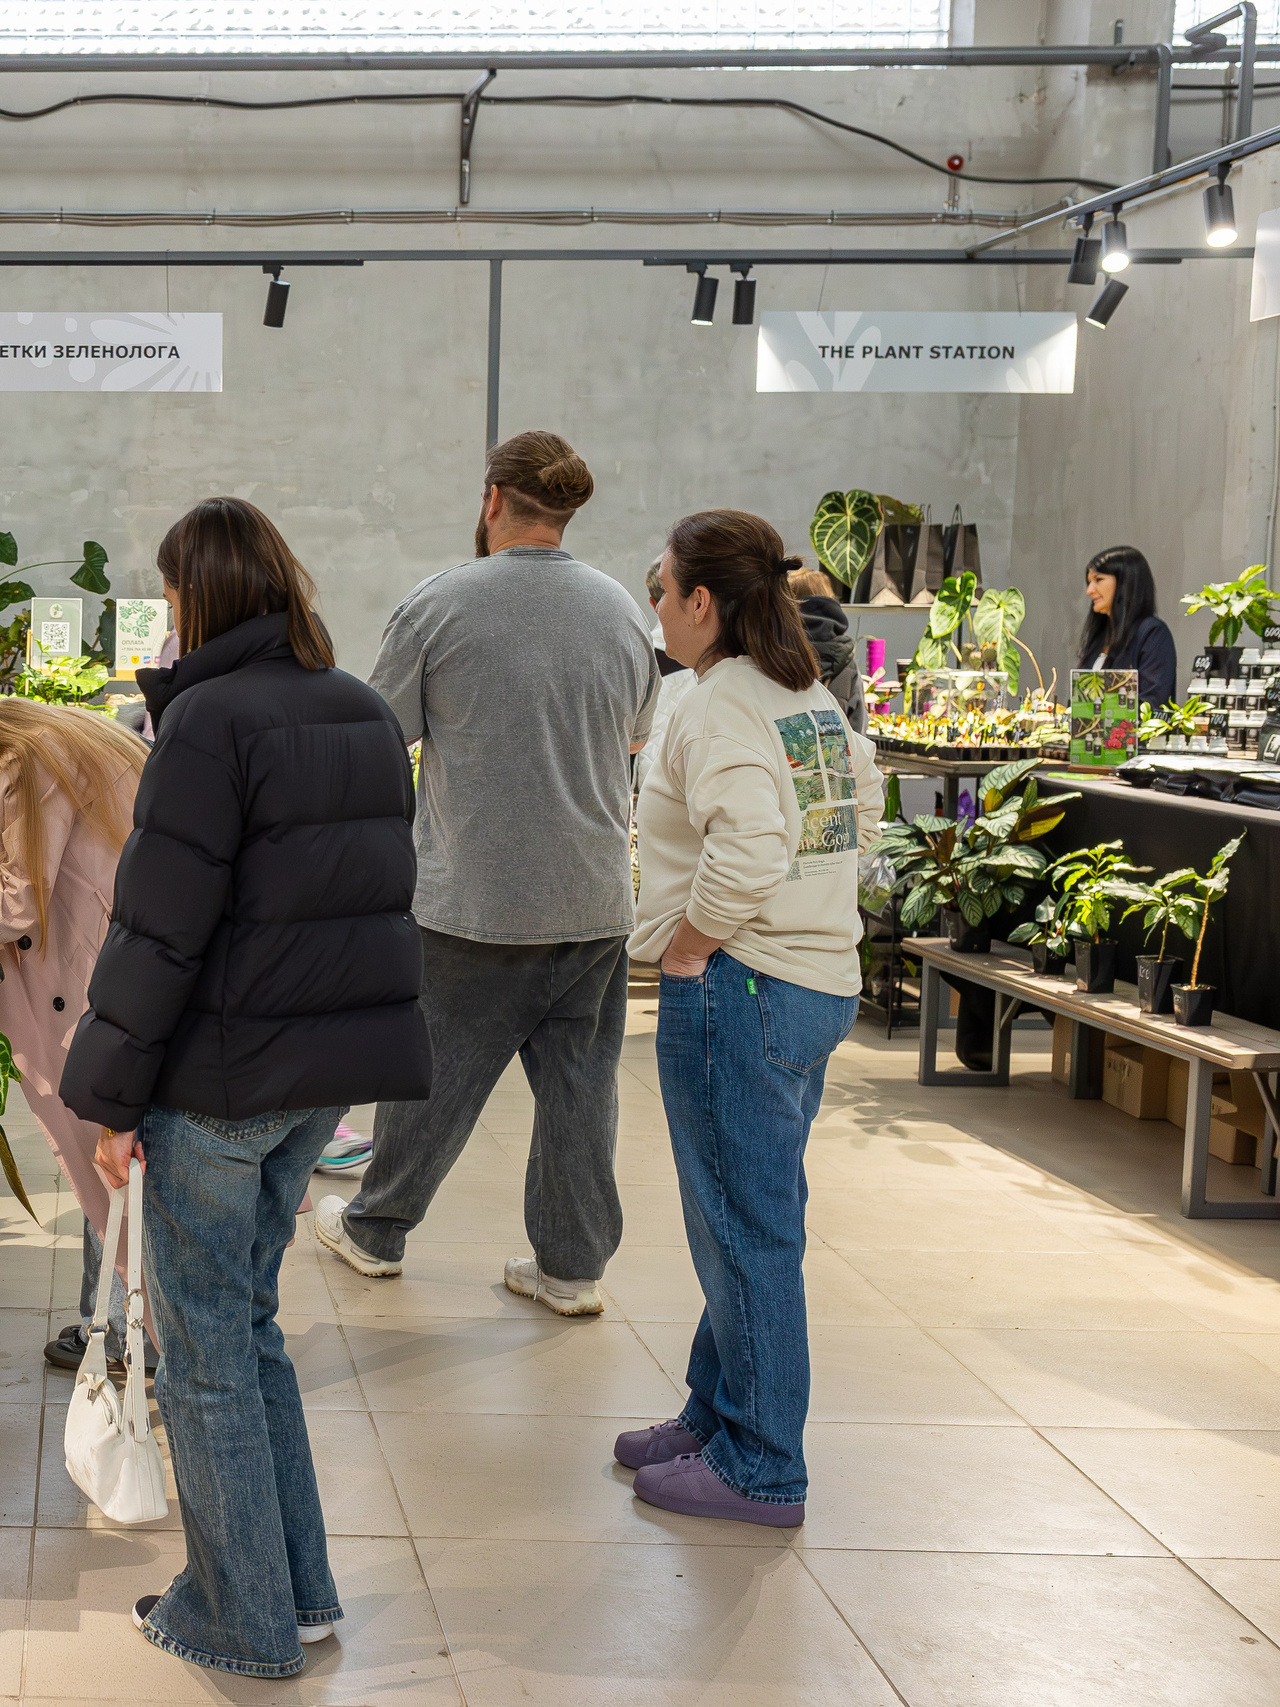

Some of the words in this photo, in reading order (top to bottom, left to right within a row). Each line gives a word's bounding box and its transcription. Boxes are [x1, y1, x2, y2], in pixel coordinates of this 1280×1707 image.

[53, 345, 180, 359] ЗЕЛЕНОЛОГА
[819, 345, 855, 359] THE
[862, 345, 924, 359] PLANT
[929, 345, 1015, 360] STATION
